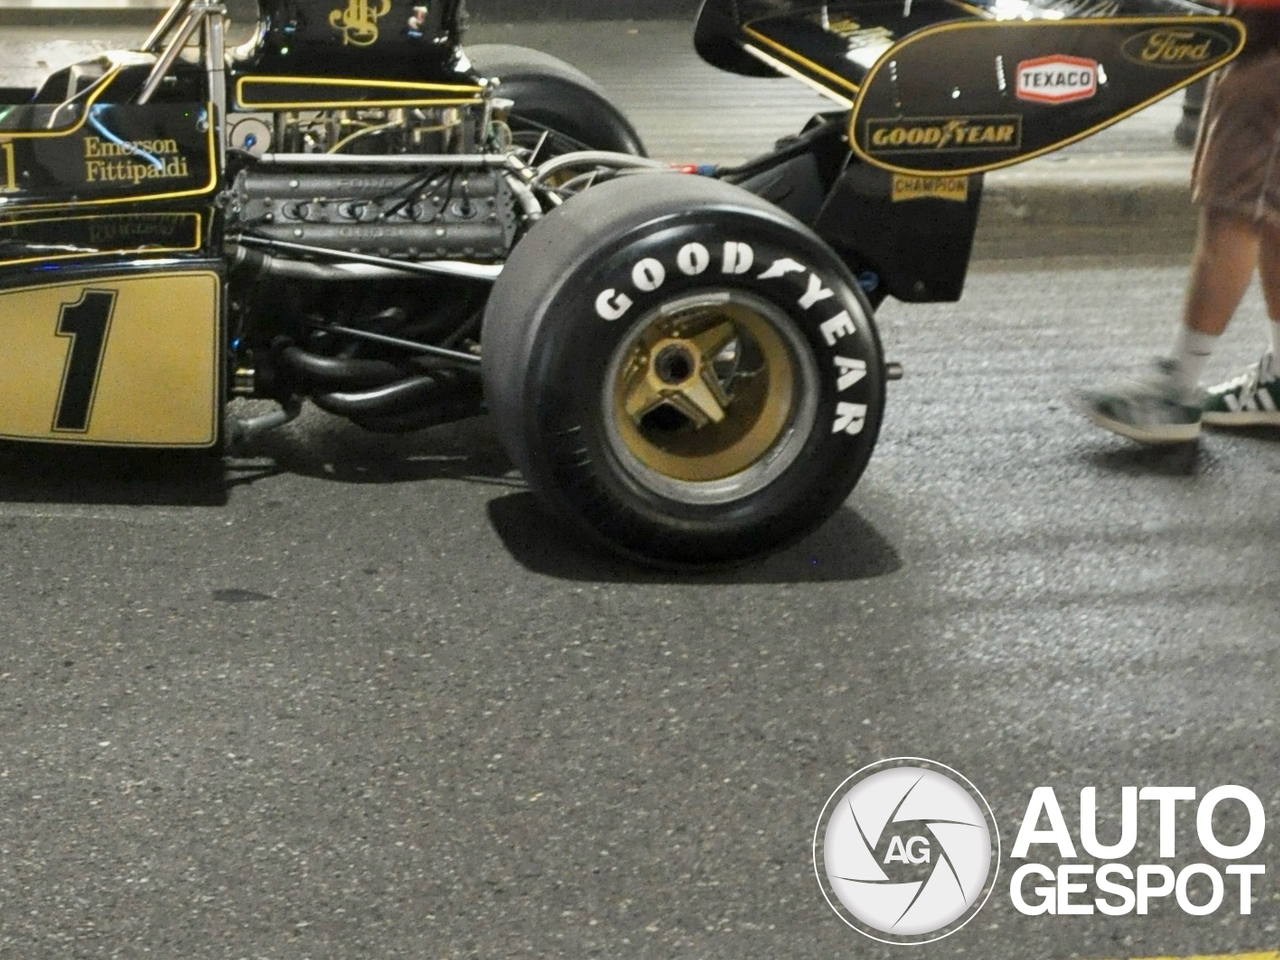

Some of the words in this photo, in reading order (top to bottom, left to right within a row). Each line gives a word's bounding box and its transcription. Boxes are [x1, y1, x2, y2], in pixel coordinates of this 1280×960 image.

[1142, 31, 1211, 60] Ford
[1022, 70, 1093, 89] TEXACO
[83, 136, 179, 158] Emerson
[873, 118, 1015, 149] GOODYEAR
[85, 157, 190, 185] Fittipaldi
[895, 175, 966, 193] CHAMPION
[595, 241, 868, 435] GOODYEAR
[50, 287, 119, 433] 1
